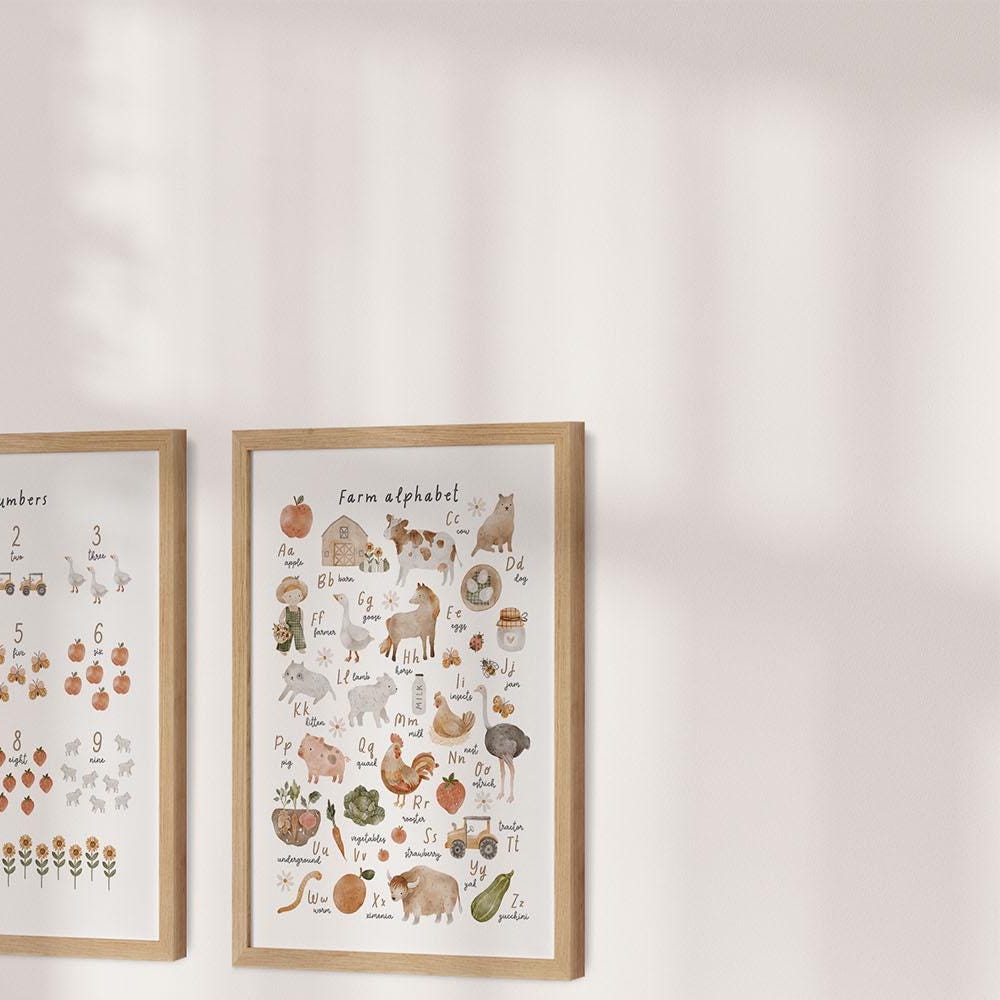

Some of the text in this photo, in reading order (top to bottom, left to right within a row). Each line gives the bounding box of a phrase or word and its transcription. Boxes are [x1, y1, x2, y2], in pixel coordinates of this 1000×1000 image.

[338, 483, 459, 508] Farm alphabet
[446, 511, 460, 526] Cc
[11, 525, 21, 547] 2
[91, 525, 102, 546] 3
[10, 550, 24, 562] two
[88, 549, 106, 561] three
[278, 543, 295, 557] Aa
[284, 558, 304, 569] apple
[505, 556, 525, 571] Dd
[317, 572, 355, 589] Bb barn
[514, 574, 529, 585] dog
[358, 591, 374, 612] Gg
[311, 610, 325, 627] Ff
[362, 615, 382, 624] goose
[446, 606, 462, 620] Ee
[13, 623, 24, 644] 5
[93, 623, 104, 644] 6
[313, 627, 337, 638] farmer
[450, 622, 467, 633] eggs
[12, 649, 26, 659] five
[93, 648, 104, 657] six
[403, 649, 420, 665] Hh
[394, 666, 413, 675] horse
[500, 657, 516, 677] Jj
[336, 669, 371, 685] Ll lamb
[504, 681, 521, 691] jam
[415, 685, 423, 710] MILK
[449, 690, 473, 702] insects
[293, 701, 310, 718] Kk
[305, 716, 326, 727] kitten
[394, 712, 418, 727] Mm
[408, 728, 424, 738] milk
[12, 730, 22, 751] 8
[92, 731, 103, 753] 9
[274, 735, 293, 756] Pp
[358, 737, 375, 759] Qq
[463, 743, 479, 755] nest
[8, 752, 28, 767] eight
[89, 755, 106, 764] nine
[356, 759, 378, 769] quack
[448, 750, 466, 764] Nn
[280, 759, 293, 770] pig
[474, 761, 491, 777] Oo
[472, 777, 497, 789] ostrich
[413, 795, 430, 810] Rr
[402, 812, 426, 824] rooster
[498, 820, 525, 832] tractor
[351, 832, 386, 845] vegetables
[423, 827, 437, 844] Ss
[312, 841, 329, 856] Uu
[507, 835, 519, 852] Tt
[277, 854, 322, 867] underground
[353, 848, 367, 862] Vv
[404, 847, 442, 861] strawberry
[470, 860, 487, 881] Yy
[463, 879, 477, 891] yak
[307, 890, 329, 904] Ww
[372, 892, 386, 908] Xx
[511, 894, 525, 908] Zz
[366, 911, 394, 920] ximenia
[497, 911, 530, 923] zucchini
